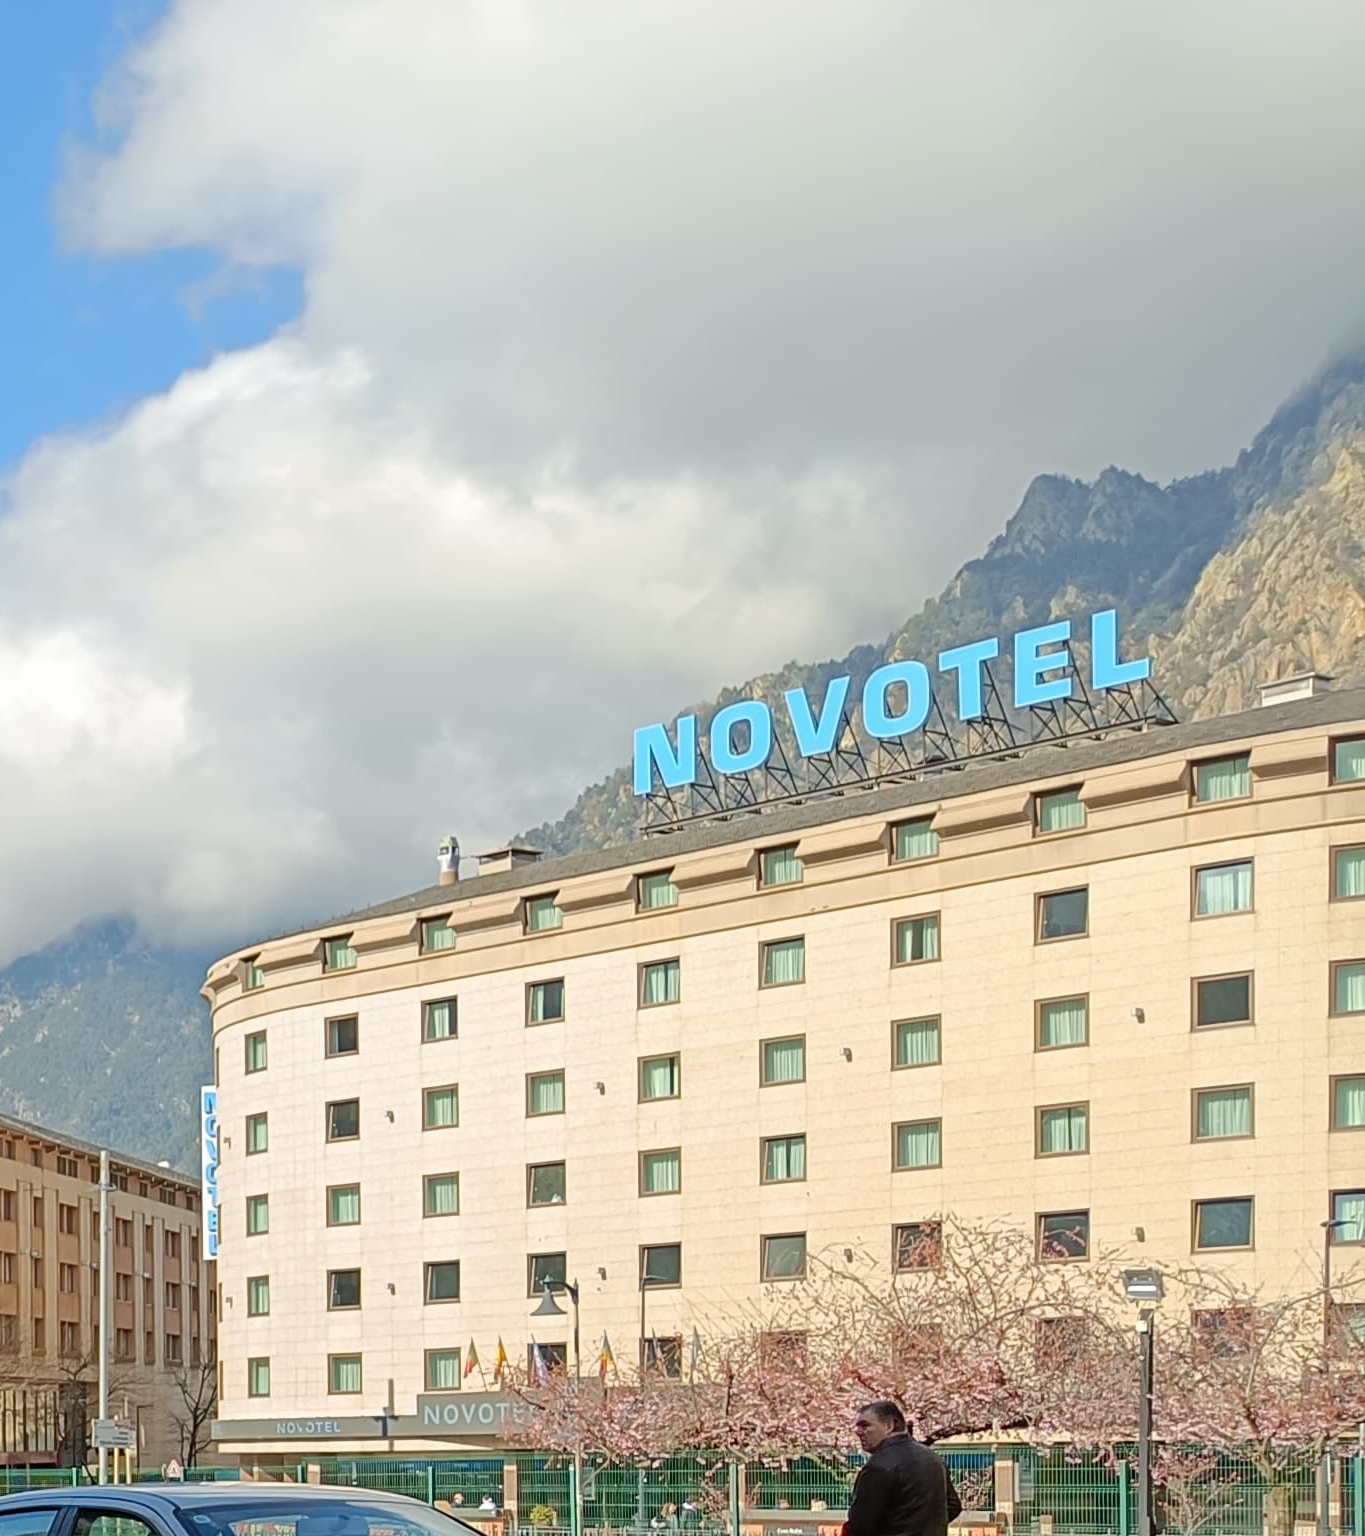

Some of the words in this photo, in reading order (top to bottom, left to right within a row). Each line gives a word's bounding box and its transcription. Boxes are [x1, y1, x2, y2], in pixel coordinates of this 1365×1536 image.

[633, 609, 1151, 796] NOVOTEL
[424, 1402, 526, 1426] NOVOTE
[276, 1420, 341, 1434] NOVOTEL
